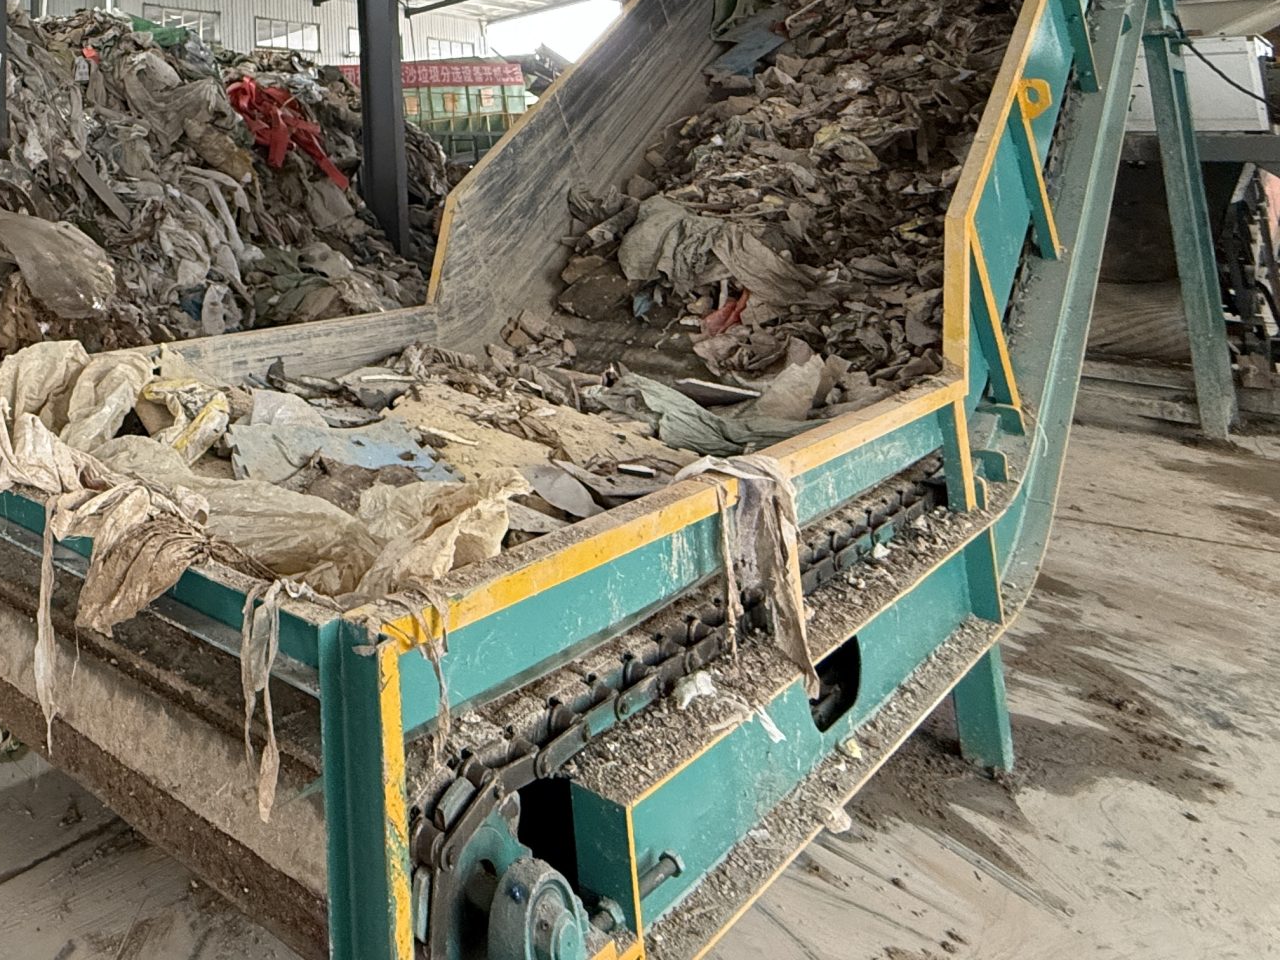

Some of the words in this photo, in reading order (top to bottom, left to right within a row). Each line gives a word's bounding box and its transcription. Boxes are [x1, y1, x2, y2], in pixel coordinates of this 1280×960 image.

[401, 65, 522, 83] 沙垃圾分选设备开机大吉
